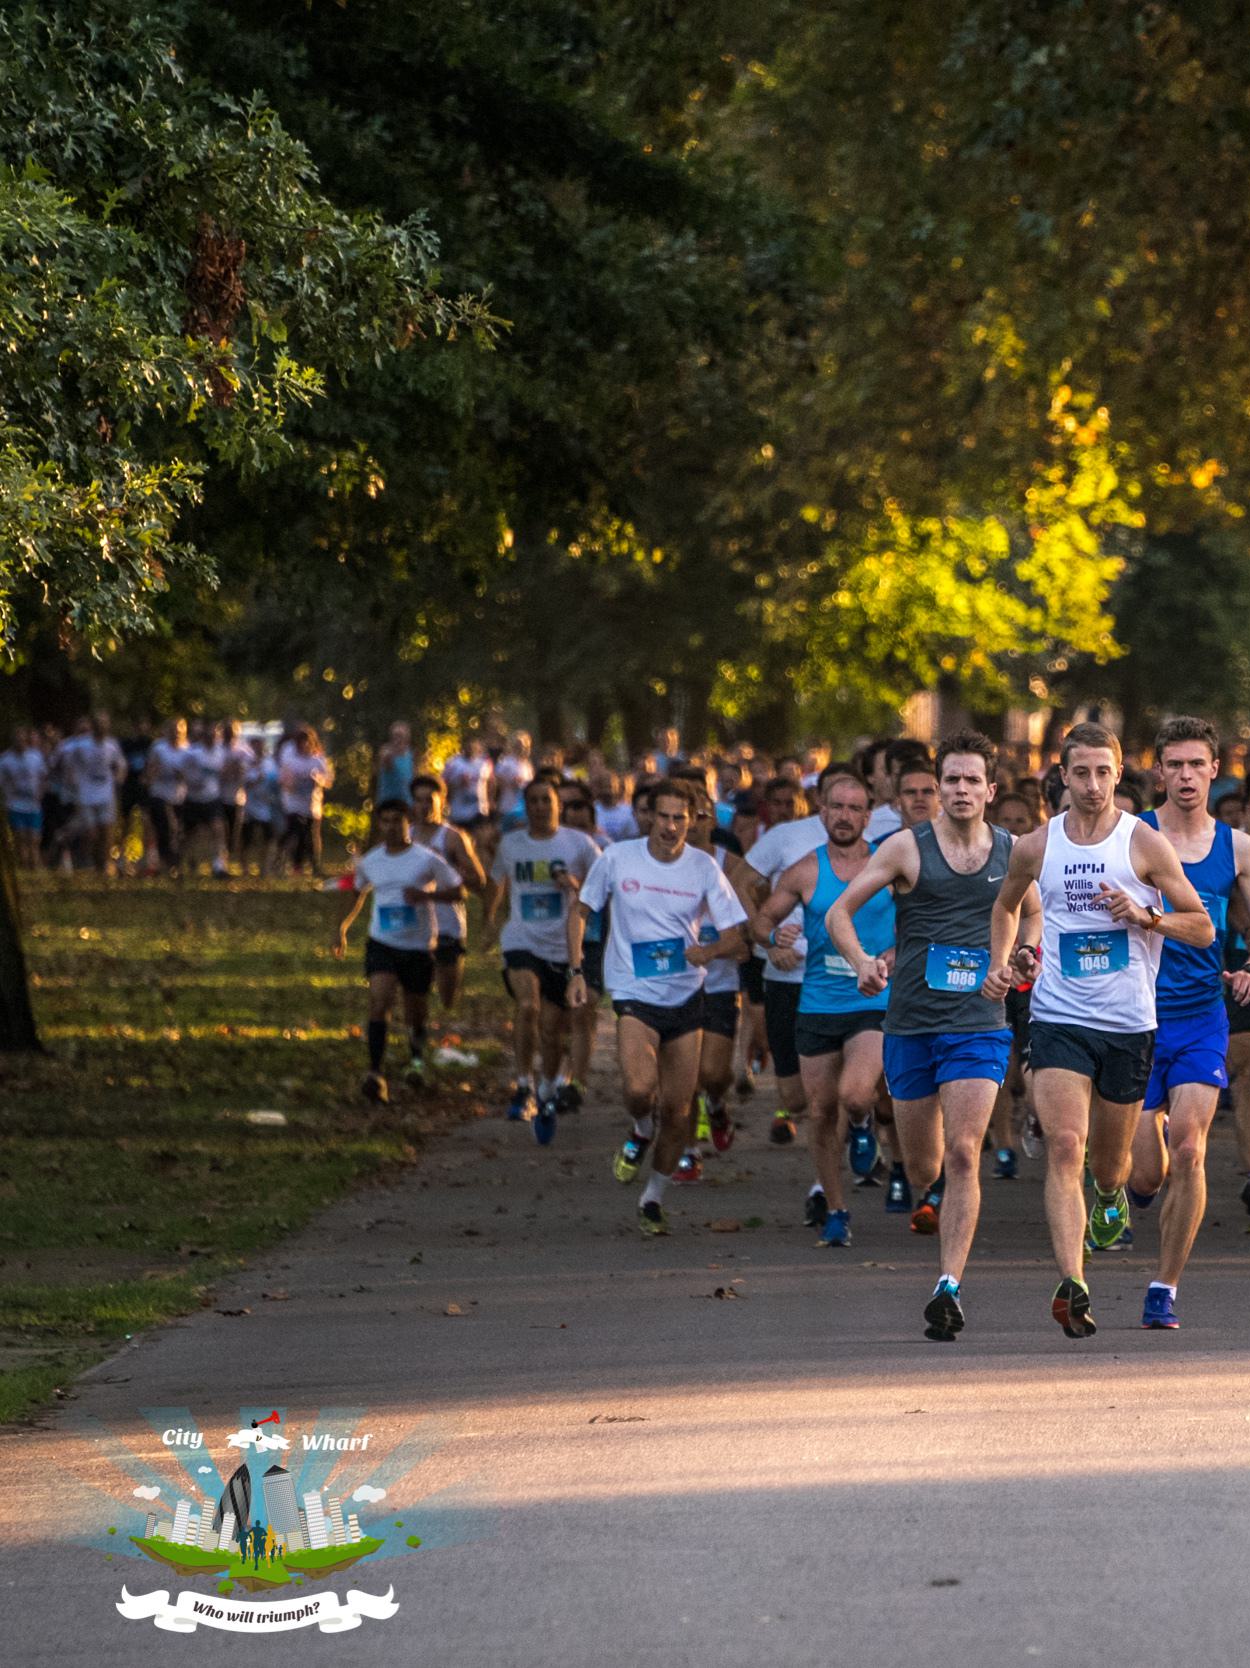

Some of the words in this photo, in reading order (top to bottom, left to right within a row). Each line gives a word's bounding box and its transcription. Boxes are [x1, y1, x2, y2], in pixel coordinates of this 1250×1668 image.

[1064, 880, 1093, 890] Willis
[1064, 891, 1100, 902] Tower
[1067, 902, 1109, 912] Watson
[1078, 955, 1110, 971] 1049
[946, 970, 977, 987] 1086
